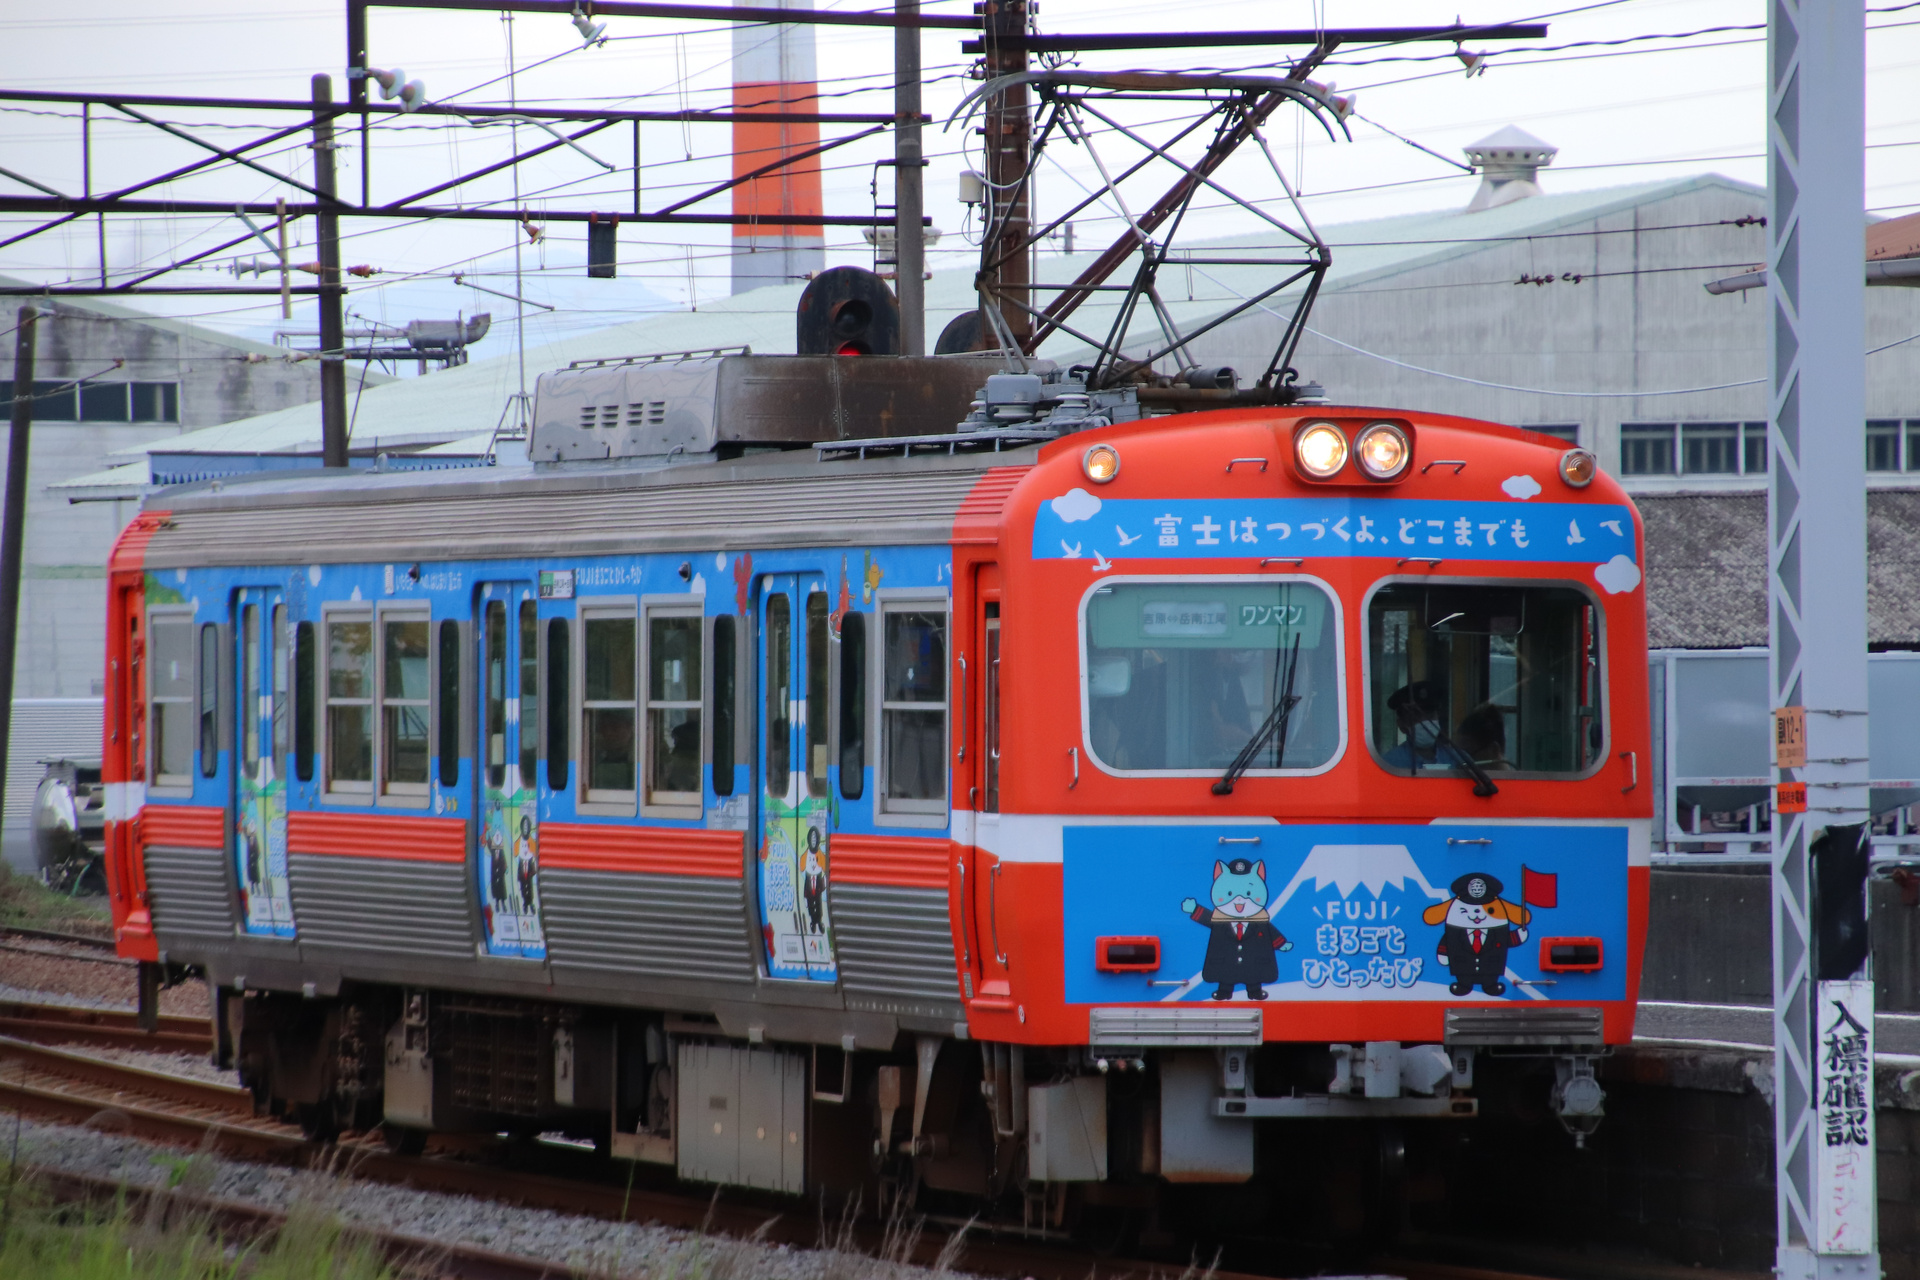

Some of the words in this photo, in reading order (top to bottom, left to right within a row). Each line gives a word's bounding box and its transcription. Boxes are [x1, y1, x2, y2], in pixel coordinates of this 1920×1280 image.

[1154, 513, 1530, 548] 富士はつづくよ、どこまでも
[1243, 606, 1302, 625] ワンマン
[1327, 901, 1387, 920] FUJI
[1316, 924, 1406, 956] まるごと
[1302, 956, 1423, 988] ひとったび
[1823, 1000, 1870, 1147] 入標確認
